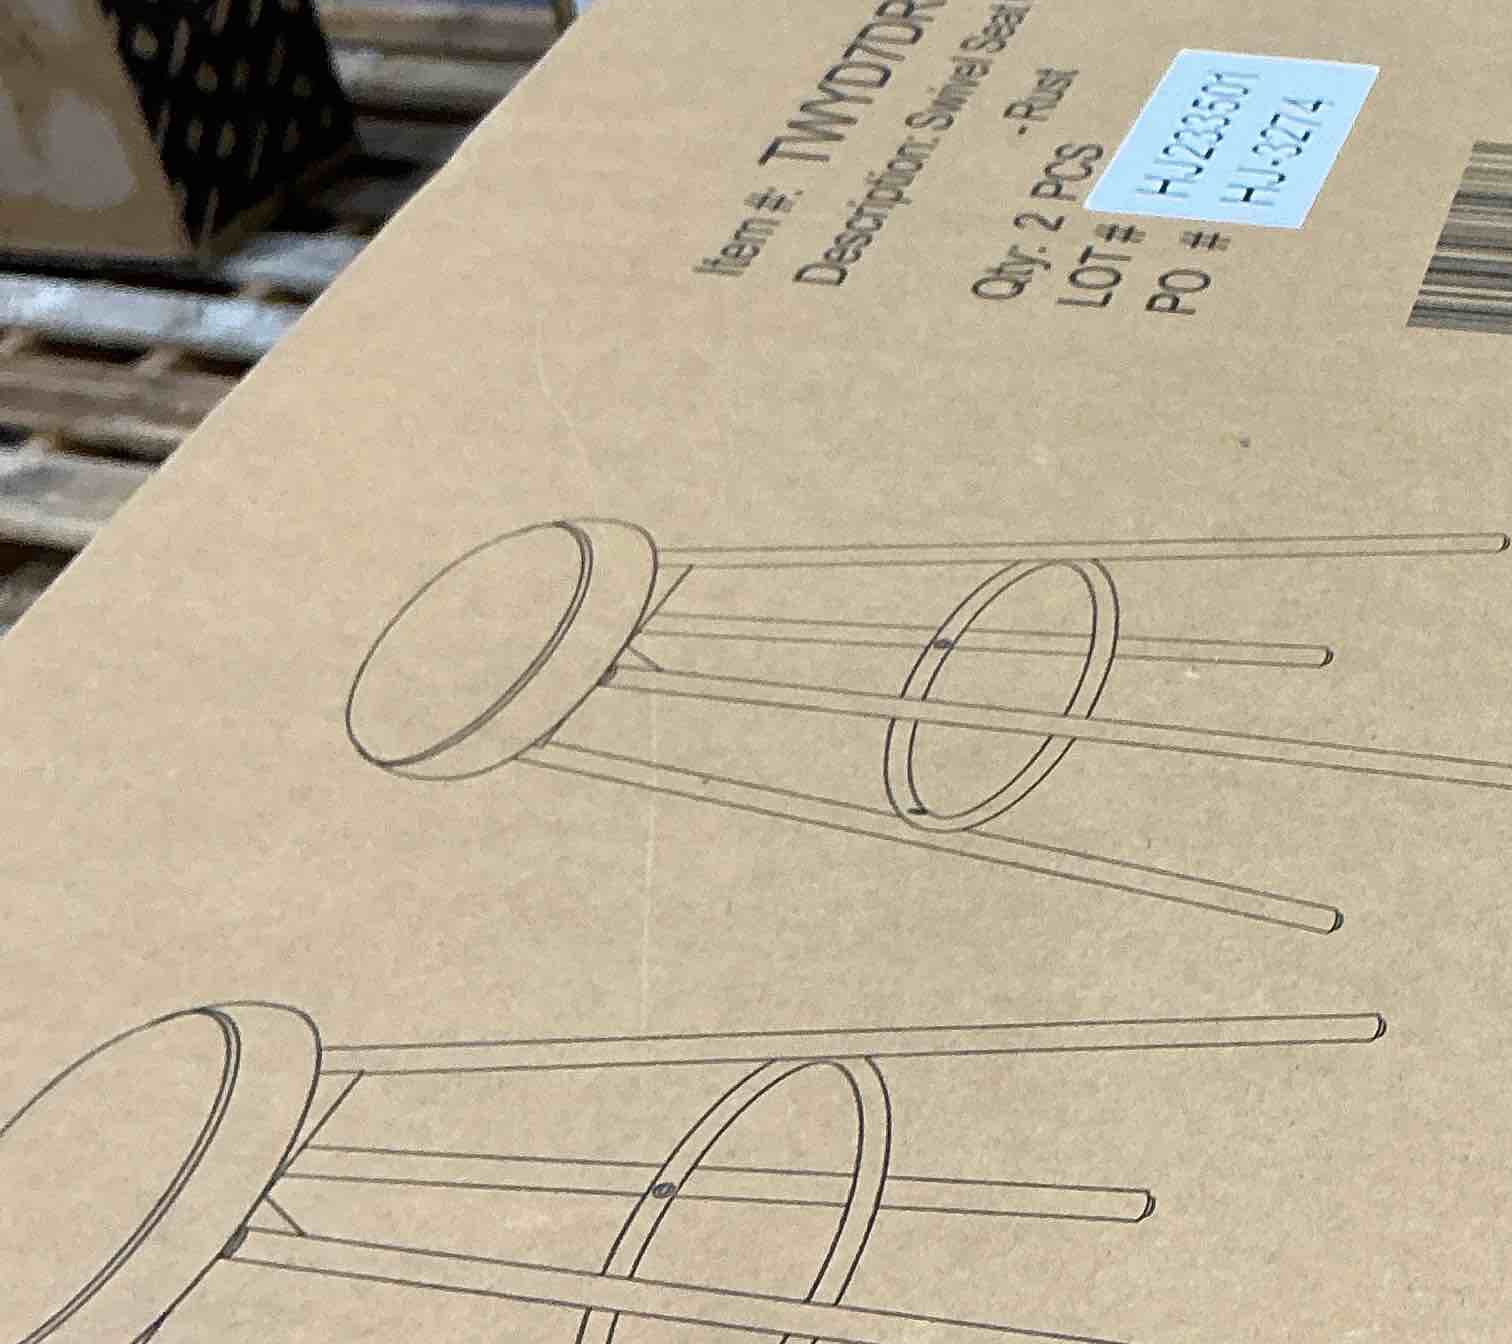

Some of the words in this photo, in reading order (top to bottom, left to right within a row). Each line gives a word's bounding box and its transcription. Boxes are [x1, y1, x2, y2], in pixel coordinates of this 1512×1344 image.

[1003, 67, 1079, 123] Rust
[1136, 70, 1260, 197] HJ233501
[1219, 96, 1335, 206] HJ-3274
[1030, 143, 1104, 202] PCS
[693, 216, 782, 276] Item
[1014, 213, 1064, 232] 2
[1057, 245, 1131, 307] LOT
[1095, 223, 1146, 244] #
[1145, 268, 1211, 315] PO
[1179, 231, 1231, 251] #
